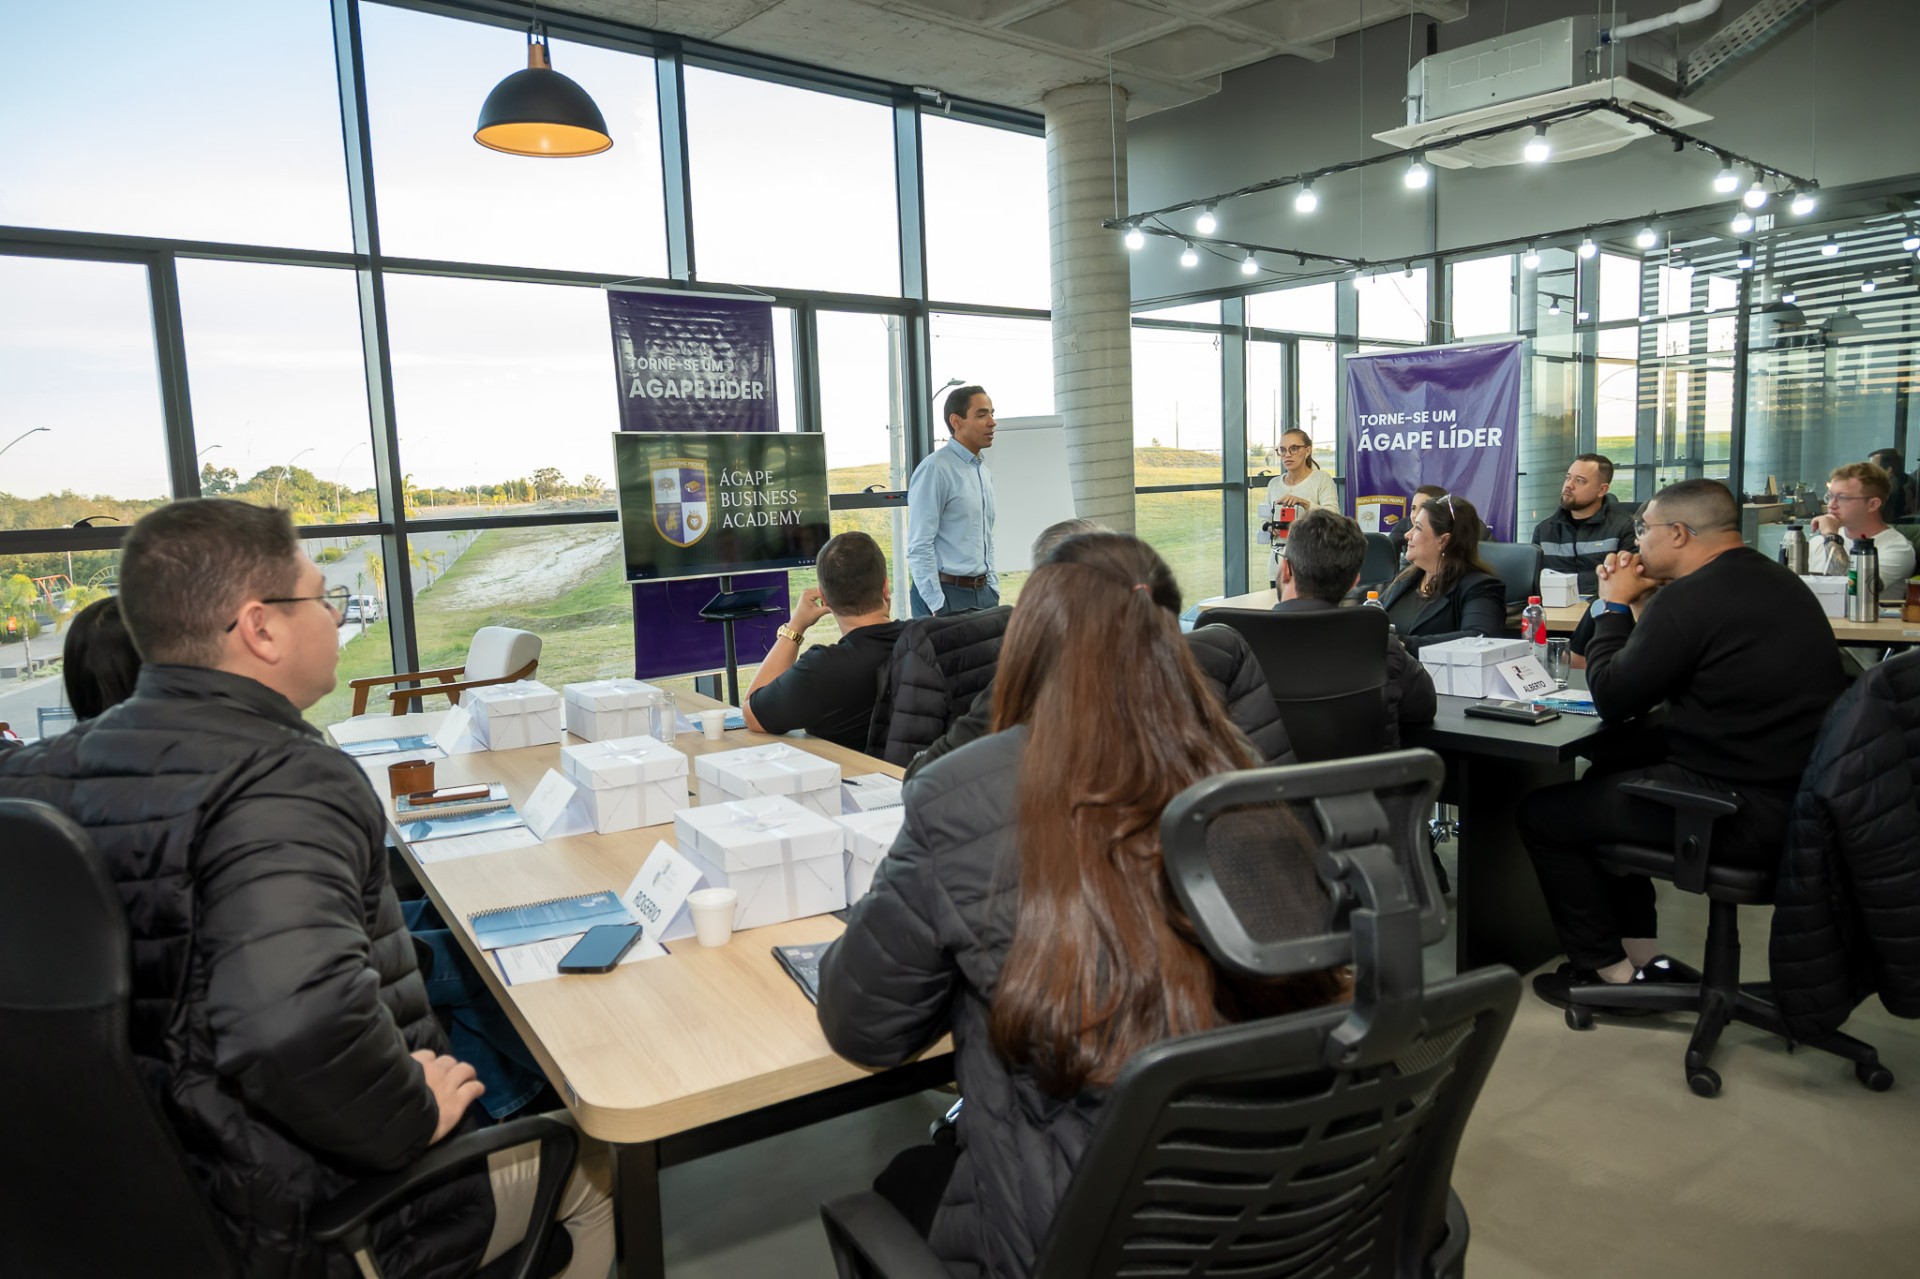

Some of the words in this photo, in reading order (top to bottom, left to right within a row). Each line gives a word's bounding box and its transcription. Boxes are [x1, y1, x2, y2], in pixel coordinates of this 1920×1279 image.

[627, 356, 700, 371] TORNE-SE
[703, 358, 724, 372] UM
[628, 371, 706, 399] ÁGAPE
[710, 374, 764, 400] LÍDER
[1359, 411, 1429, 426] TORNE-SE
[1432, 410, 1456, 422] UM
[1357, 428, 1433, 451] ÁGAPE
[1438, 423, 1502, 448] LÍDER
[719, 467, 774, 486] ÁGAPE
[720, 489, 798, 507] BUSINESS
[722, 510, 803, 529] ACADEMY
[1523, 680, 1546, 692] ALBERTO
[632, 890, 661, 923] ROGERIO
